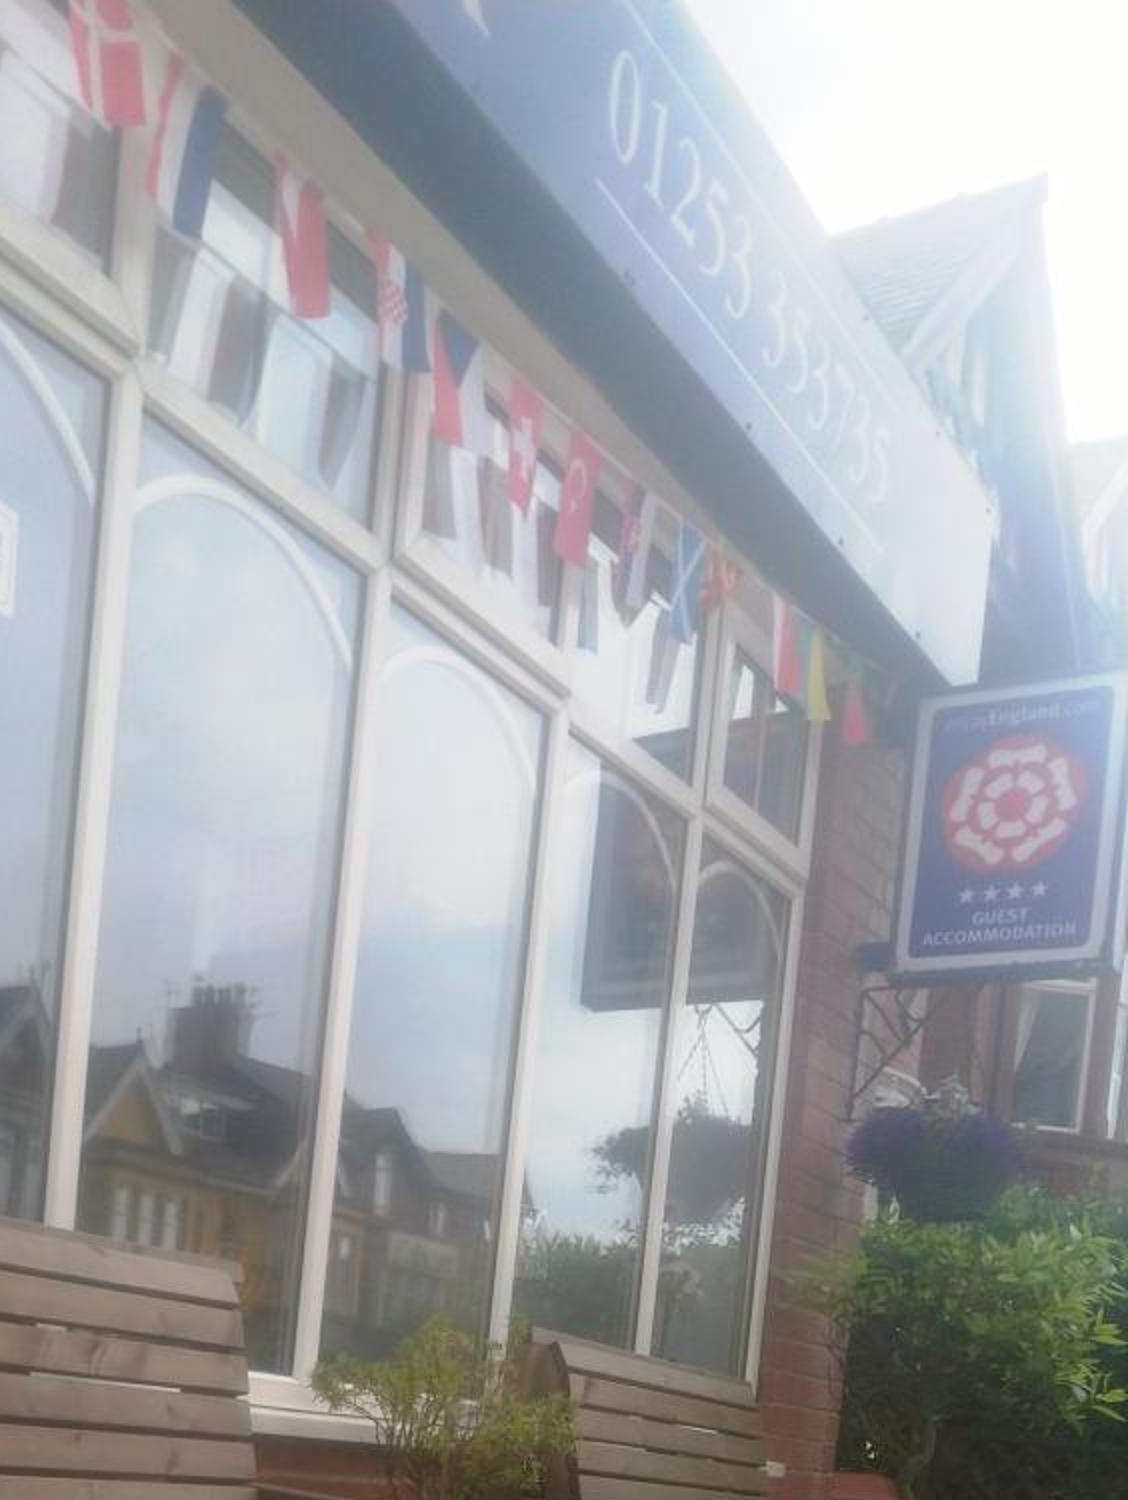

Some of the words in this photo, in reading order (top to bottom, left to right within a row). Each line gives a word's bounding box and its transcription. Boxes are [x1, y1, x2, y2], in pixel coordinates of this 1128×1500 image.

[610, 50, 753, 320] 01253
[761, 270, 890, 504] 353735
[972, 906, 1029, 924] GUEST
[923, 921, 1077, 945] ACCOMMODATION
